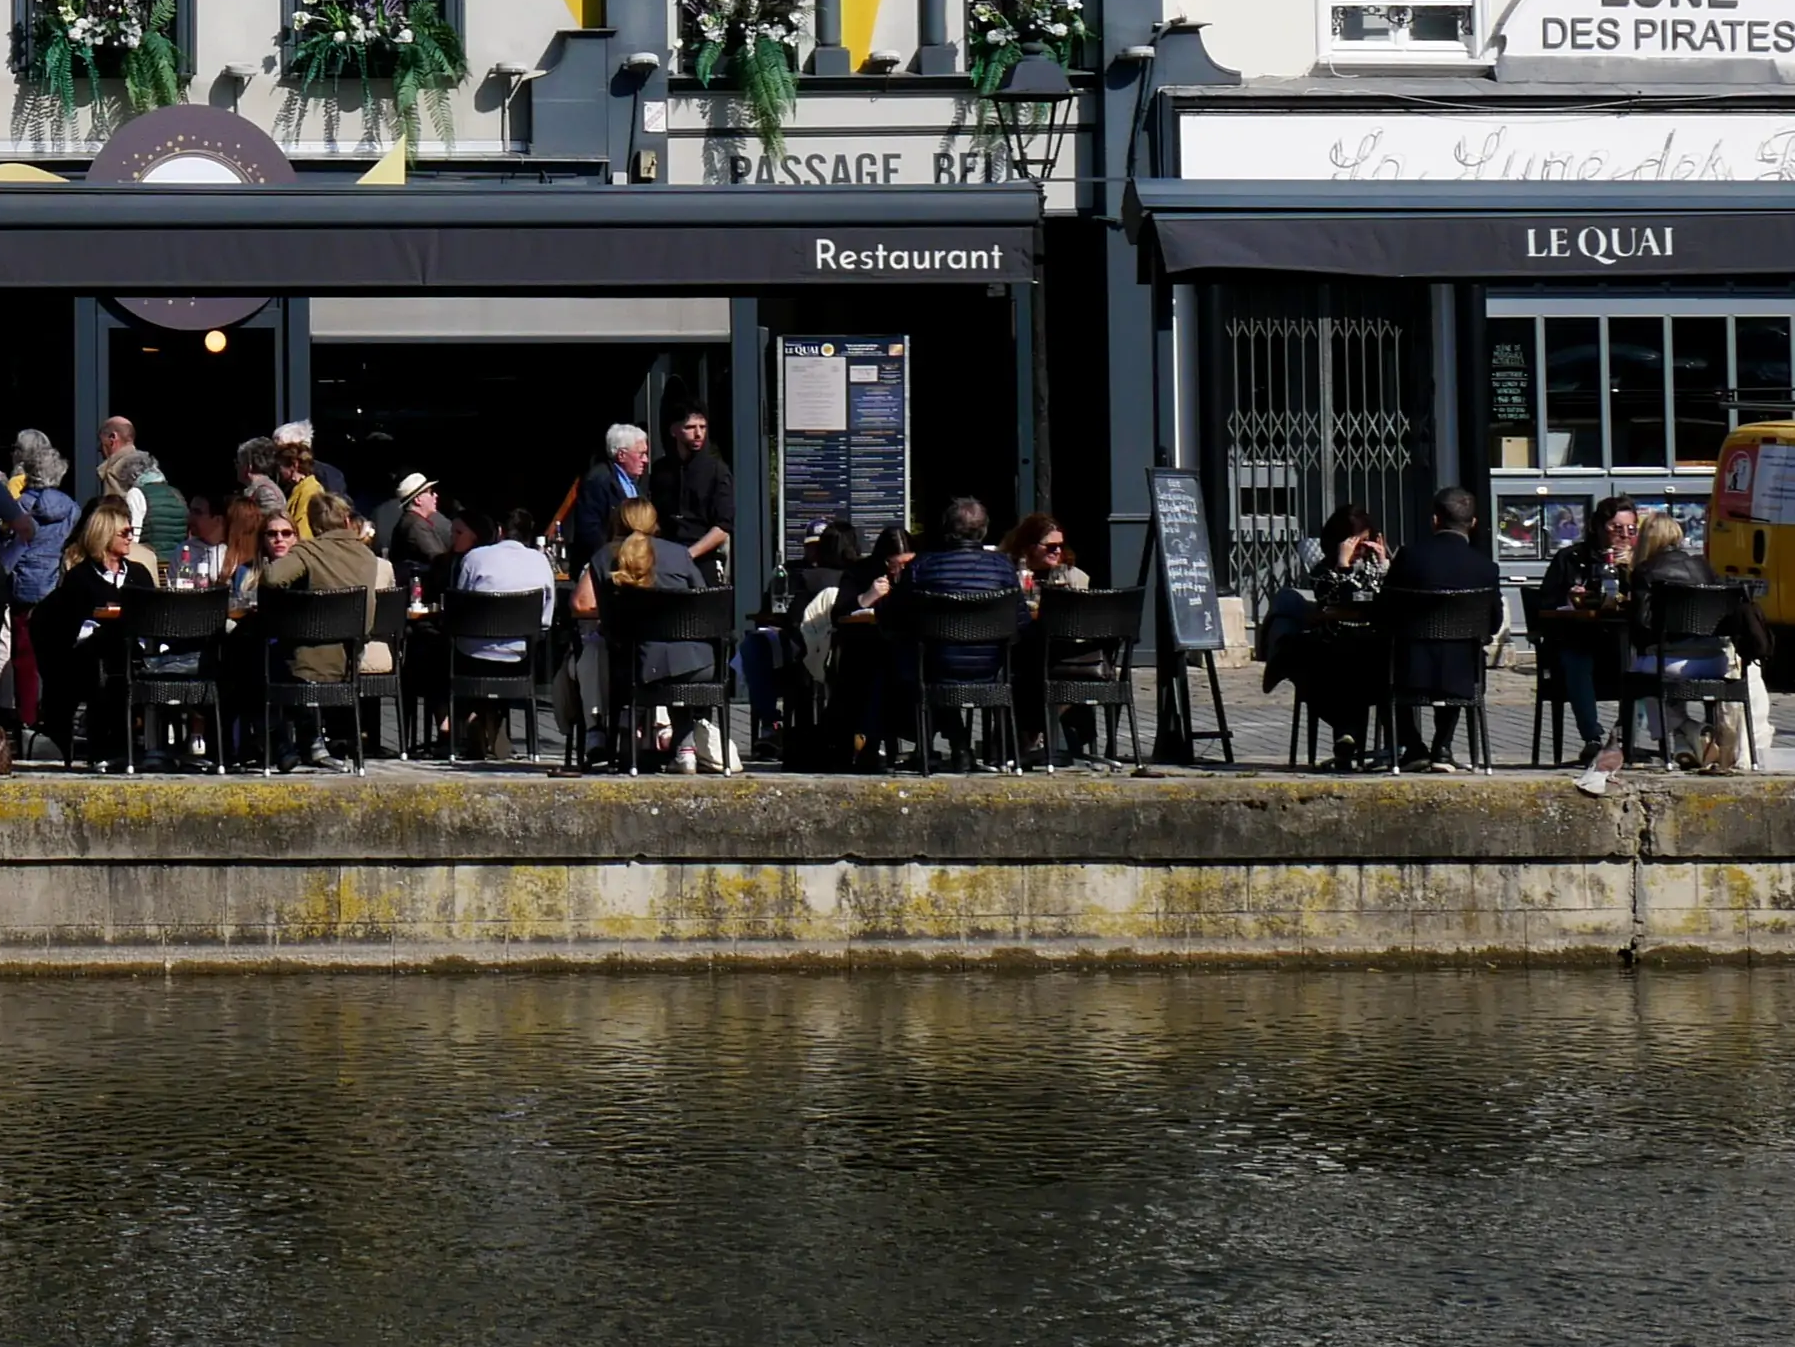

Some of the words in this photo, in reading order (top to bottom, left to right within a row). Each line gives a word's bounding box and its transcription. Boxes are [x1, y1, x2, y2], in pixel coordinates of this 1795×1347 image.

[1542, 17, 1621, 50] DES
[1634, 18, 1795, 53] PIRATES
[729, 152, 902, 184] PASSAGE
[815, 238, 1003, 270] Restaurant
[1526, 228, 1571, 258] LE
[1577, 225, 1675, 265] QUAI
[795, 345, 819, 356] QUAI
